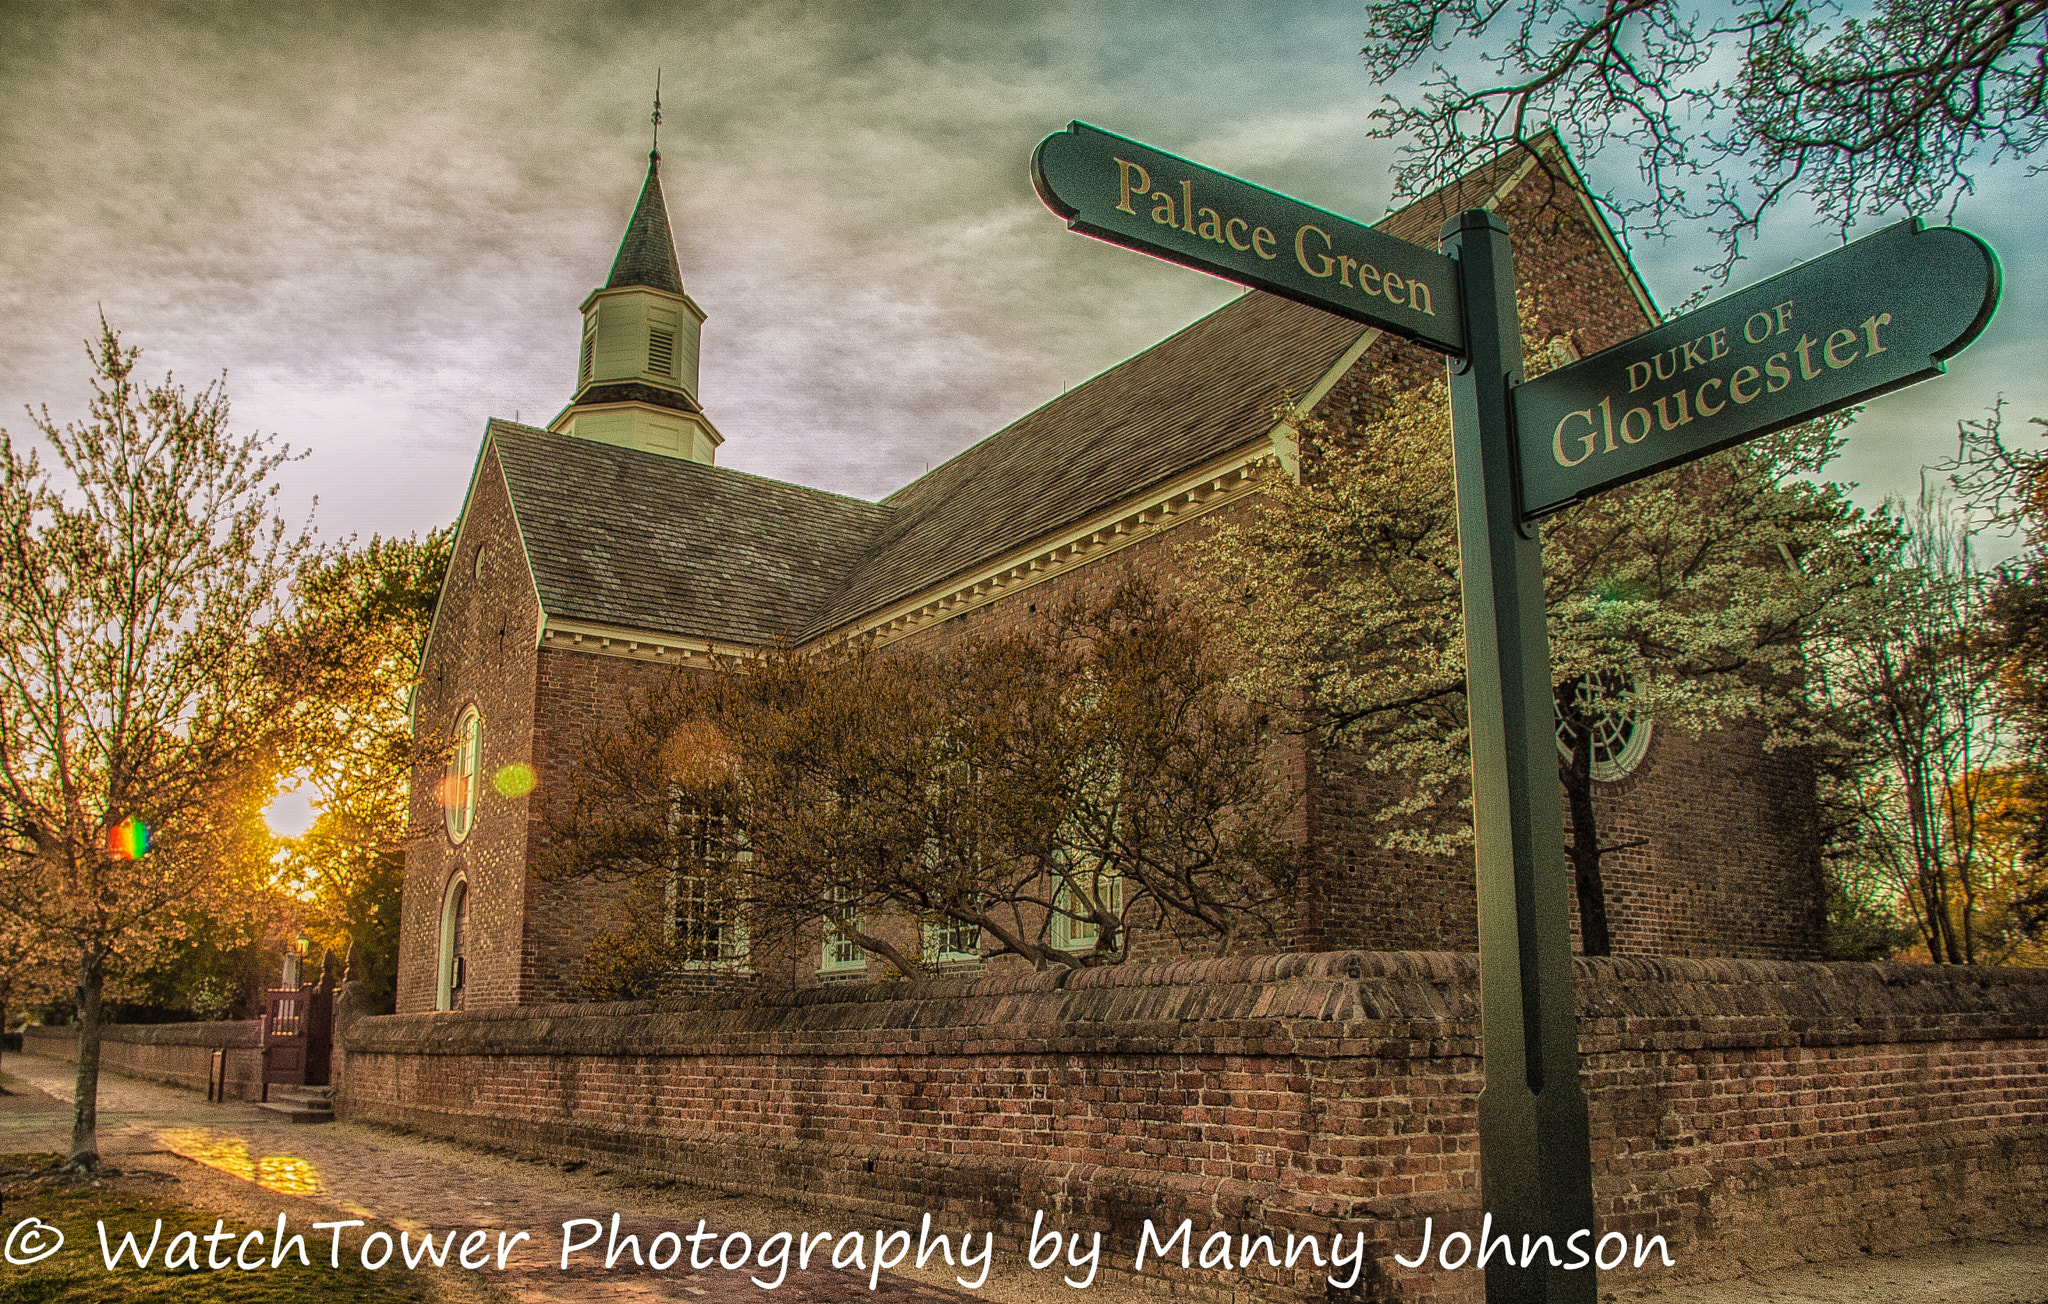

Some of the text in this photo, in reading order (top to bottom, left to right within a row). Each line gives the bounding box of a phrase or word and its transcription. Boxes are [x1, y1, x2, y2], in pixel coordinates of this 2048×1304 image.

[1112, 156, 1436, 317] Palace Green
[1551, 311, 1893, 469] Gloucester
[1624, 299, 1796, 394] DUKE OF
